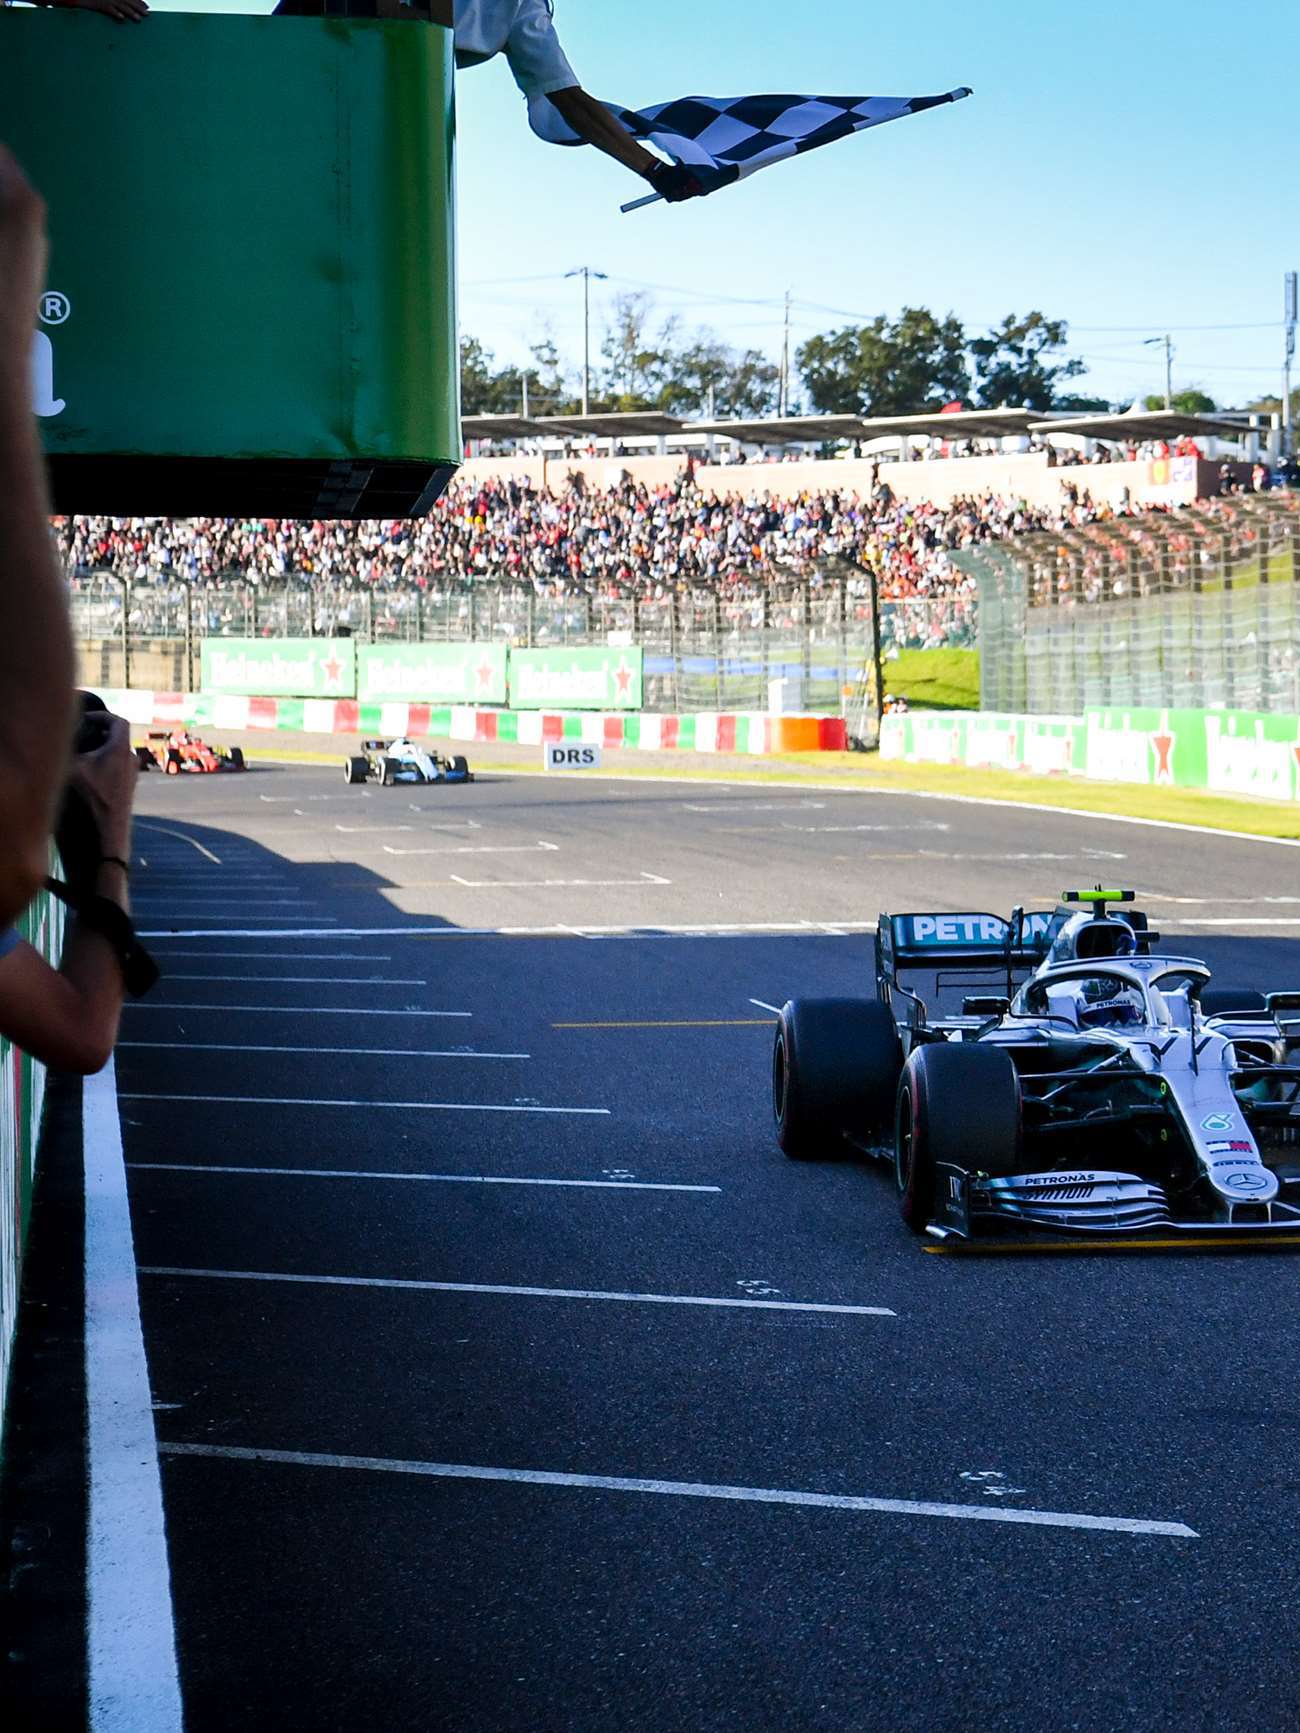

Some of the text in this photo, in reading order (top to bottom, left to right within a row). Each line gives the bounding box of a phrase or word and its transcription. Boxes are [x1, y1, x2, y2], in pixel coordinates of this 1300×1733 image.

[552, 749, 595, 764] DRS
[912, 914, 1056, 941] PETRON
[1025, 1173, 1095, 1186] PETRONAS
